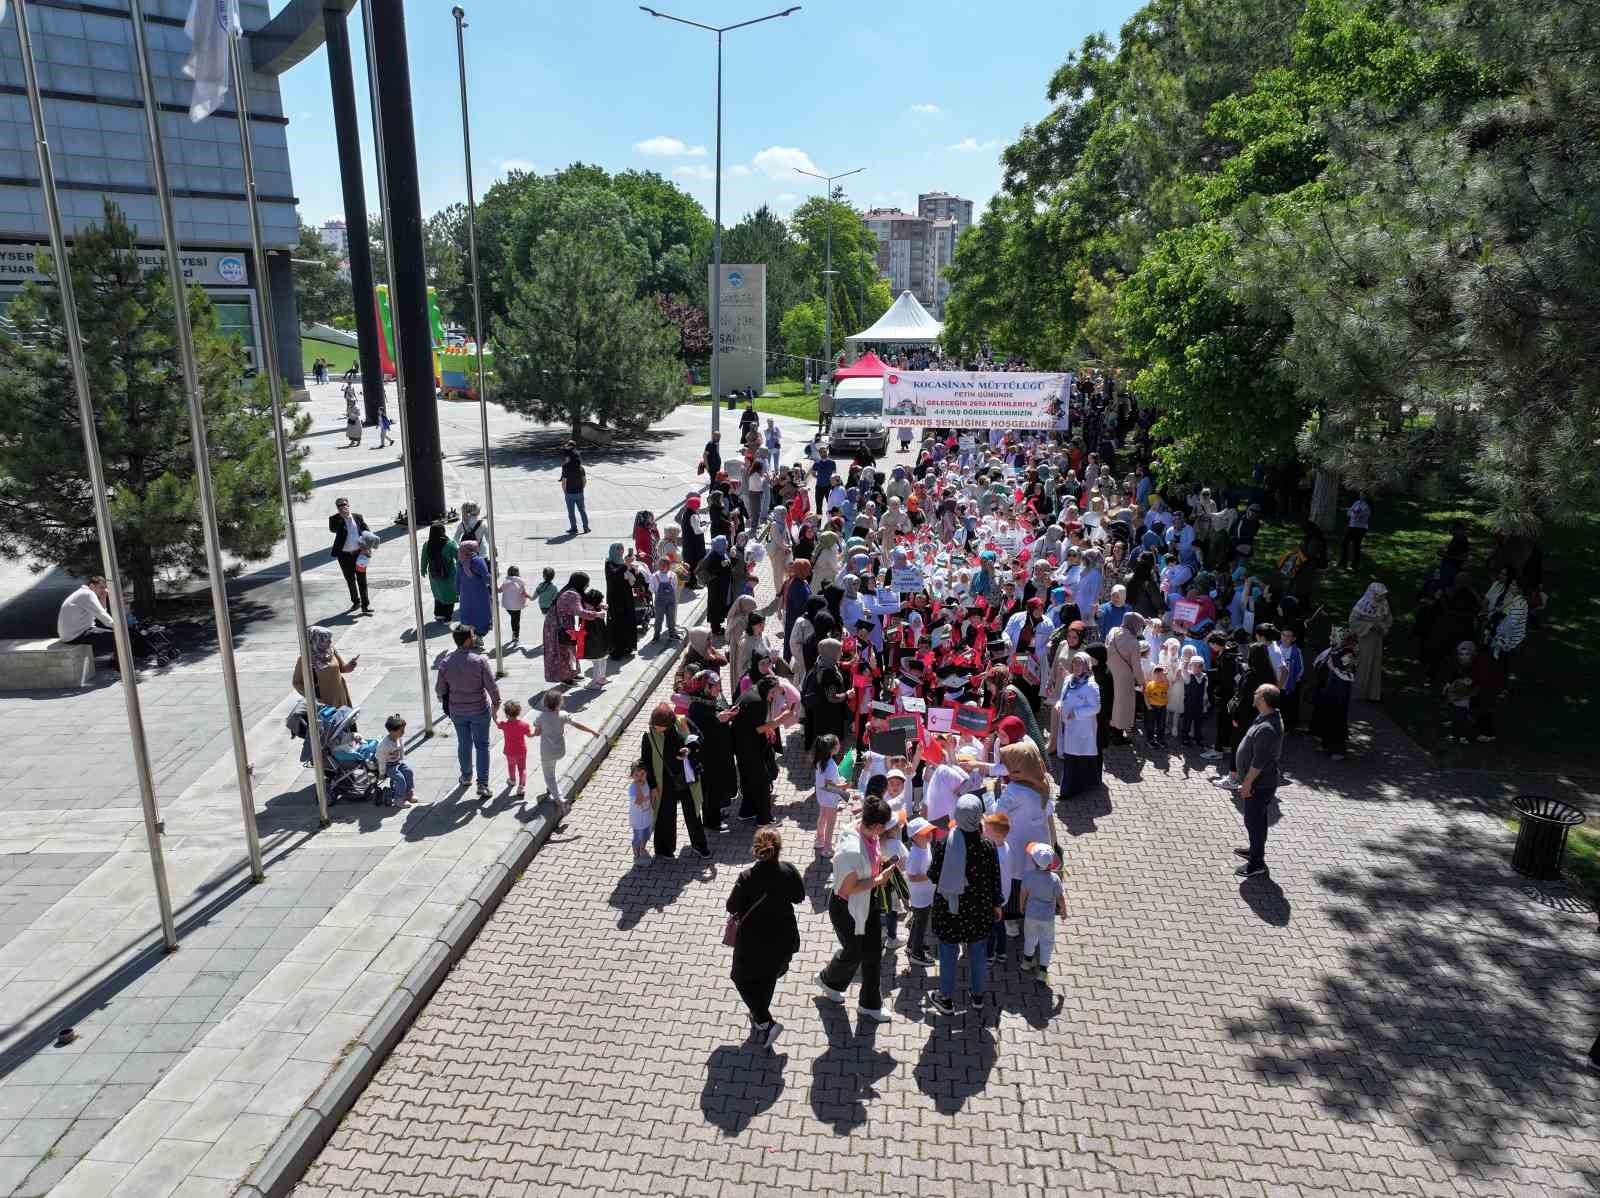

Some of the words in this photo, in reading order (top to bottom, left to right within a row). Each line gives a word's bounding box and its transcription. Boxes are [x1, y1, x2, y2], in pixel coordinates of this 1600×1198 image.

[136, 256, 208, 267] BELEYESİ
[913, 380, 974, 389] KOCASİNAN
[978, 381, 1045, 390] MÜFTÜLÜĞÜ
[946, 409, 961, 417] YAŞ
